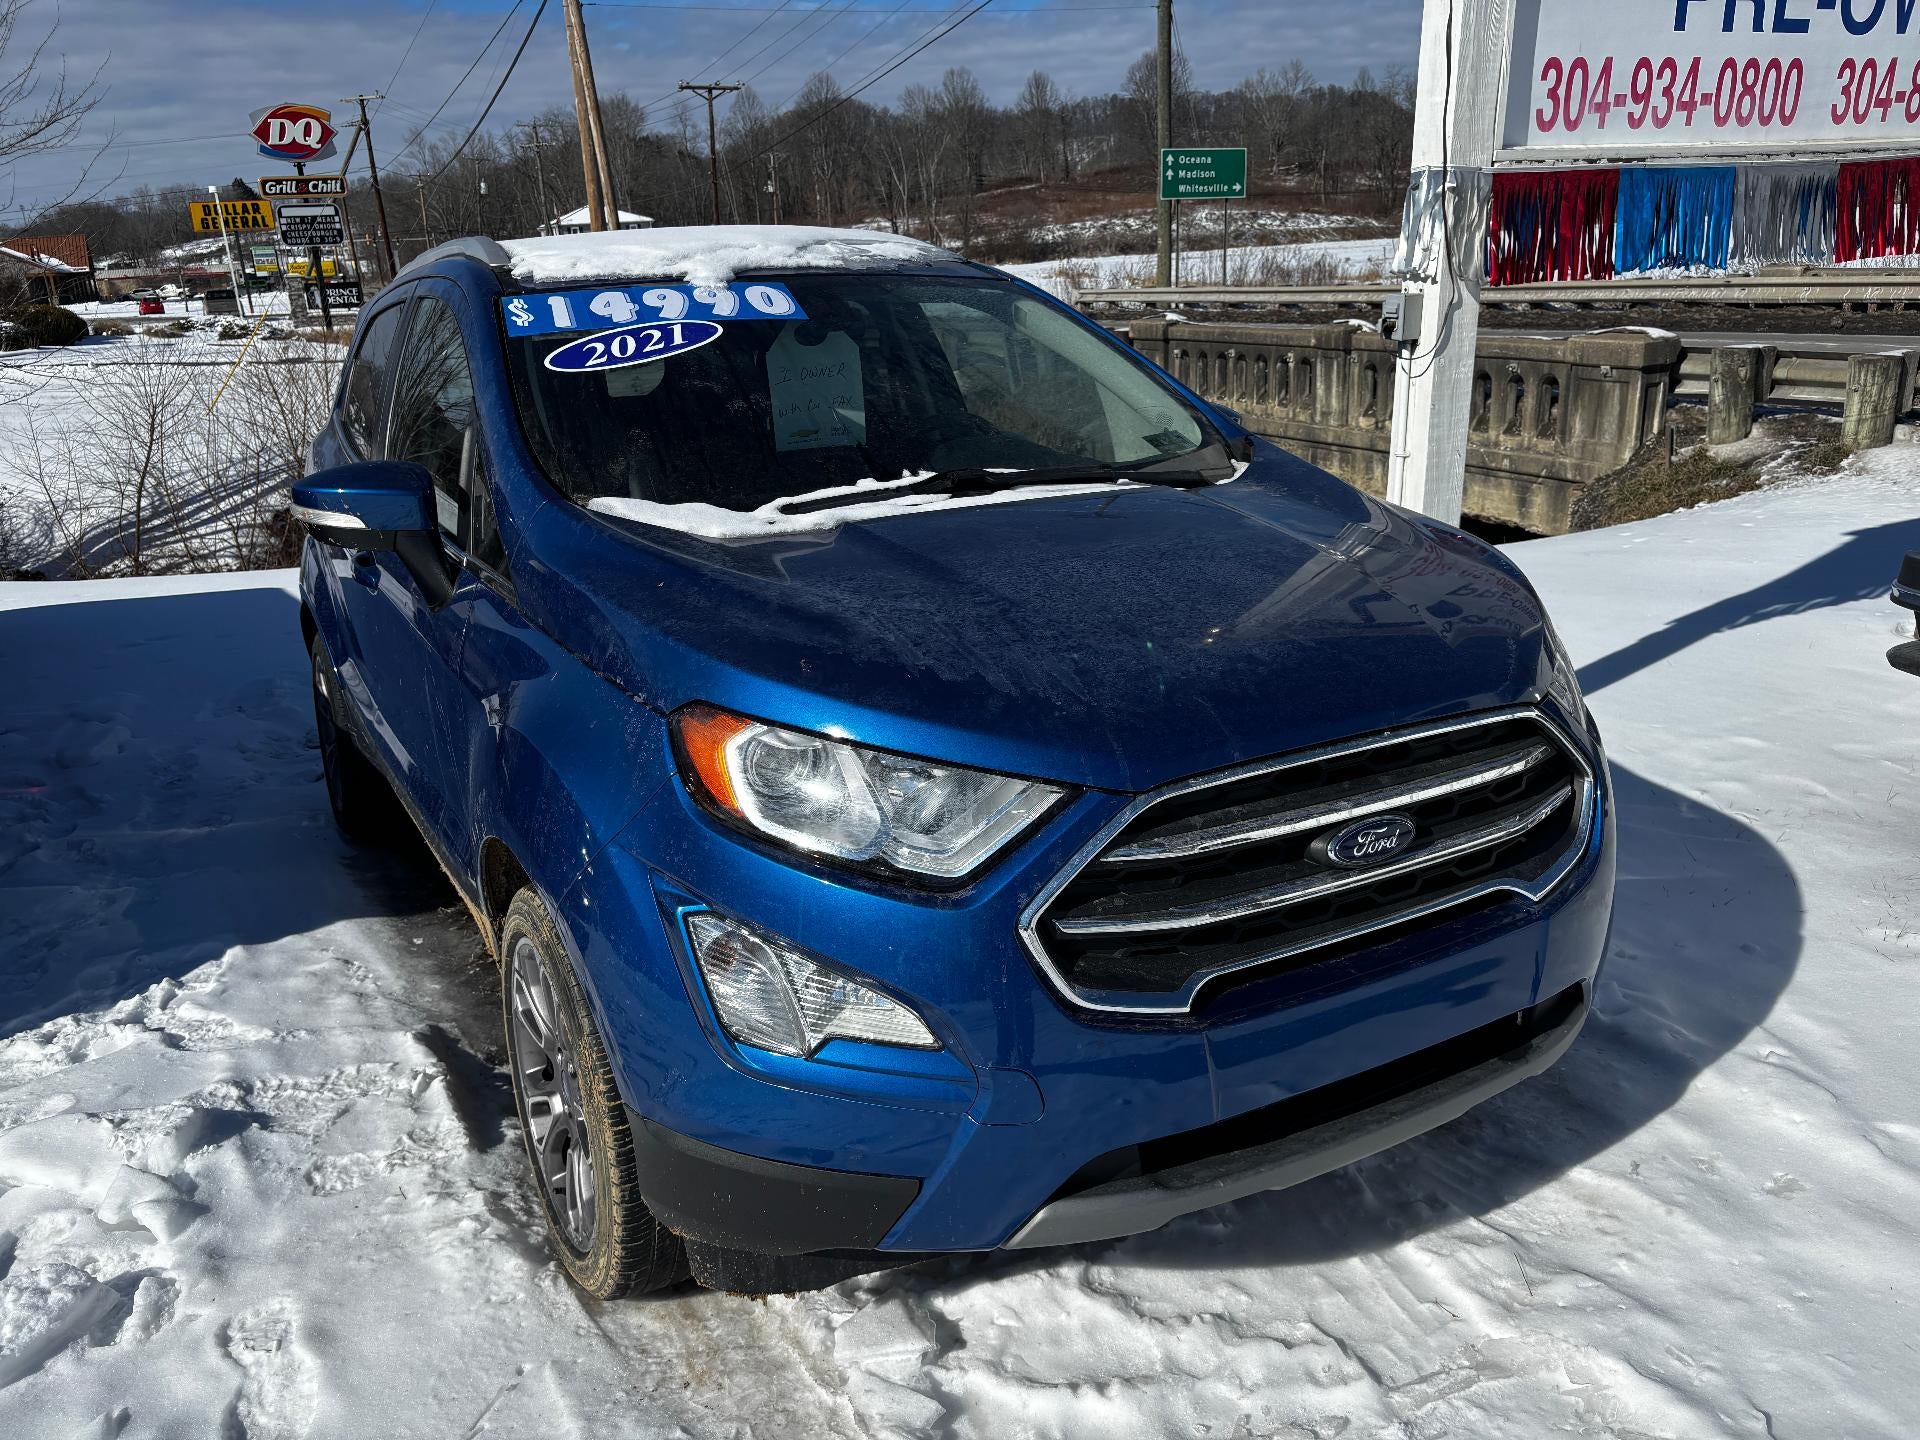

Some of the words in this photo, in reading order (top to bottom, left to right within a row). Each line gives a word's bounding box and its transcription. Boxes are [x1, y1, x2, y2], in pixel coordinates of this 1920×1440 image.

[1535, 56, 1804, 133] 304-934-0800
[267, 118, 322, 149] DQ
[1178, 155, 1212, 164] Oceana
[1178, 169, 1216, 179] Madison
[265, 181, 297, 194] Grill
[308, 180, 342, 194] Chill
[1178, 183, 1229, 193] Whitesville
[202, 202, 262, 216] DOLLAR
[200, 215, 270, 229] GENERAL
[506, 284, 796, 328] $14990
[583, 323, 689, 367] 2021
[800, 362, 848, 382] OWNER
[1353, 826, 1400, 856] Ford
